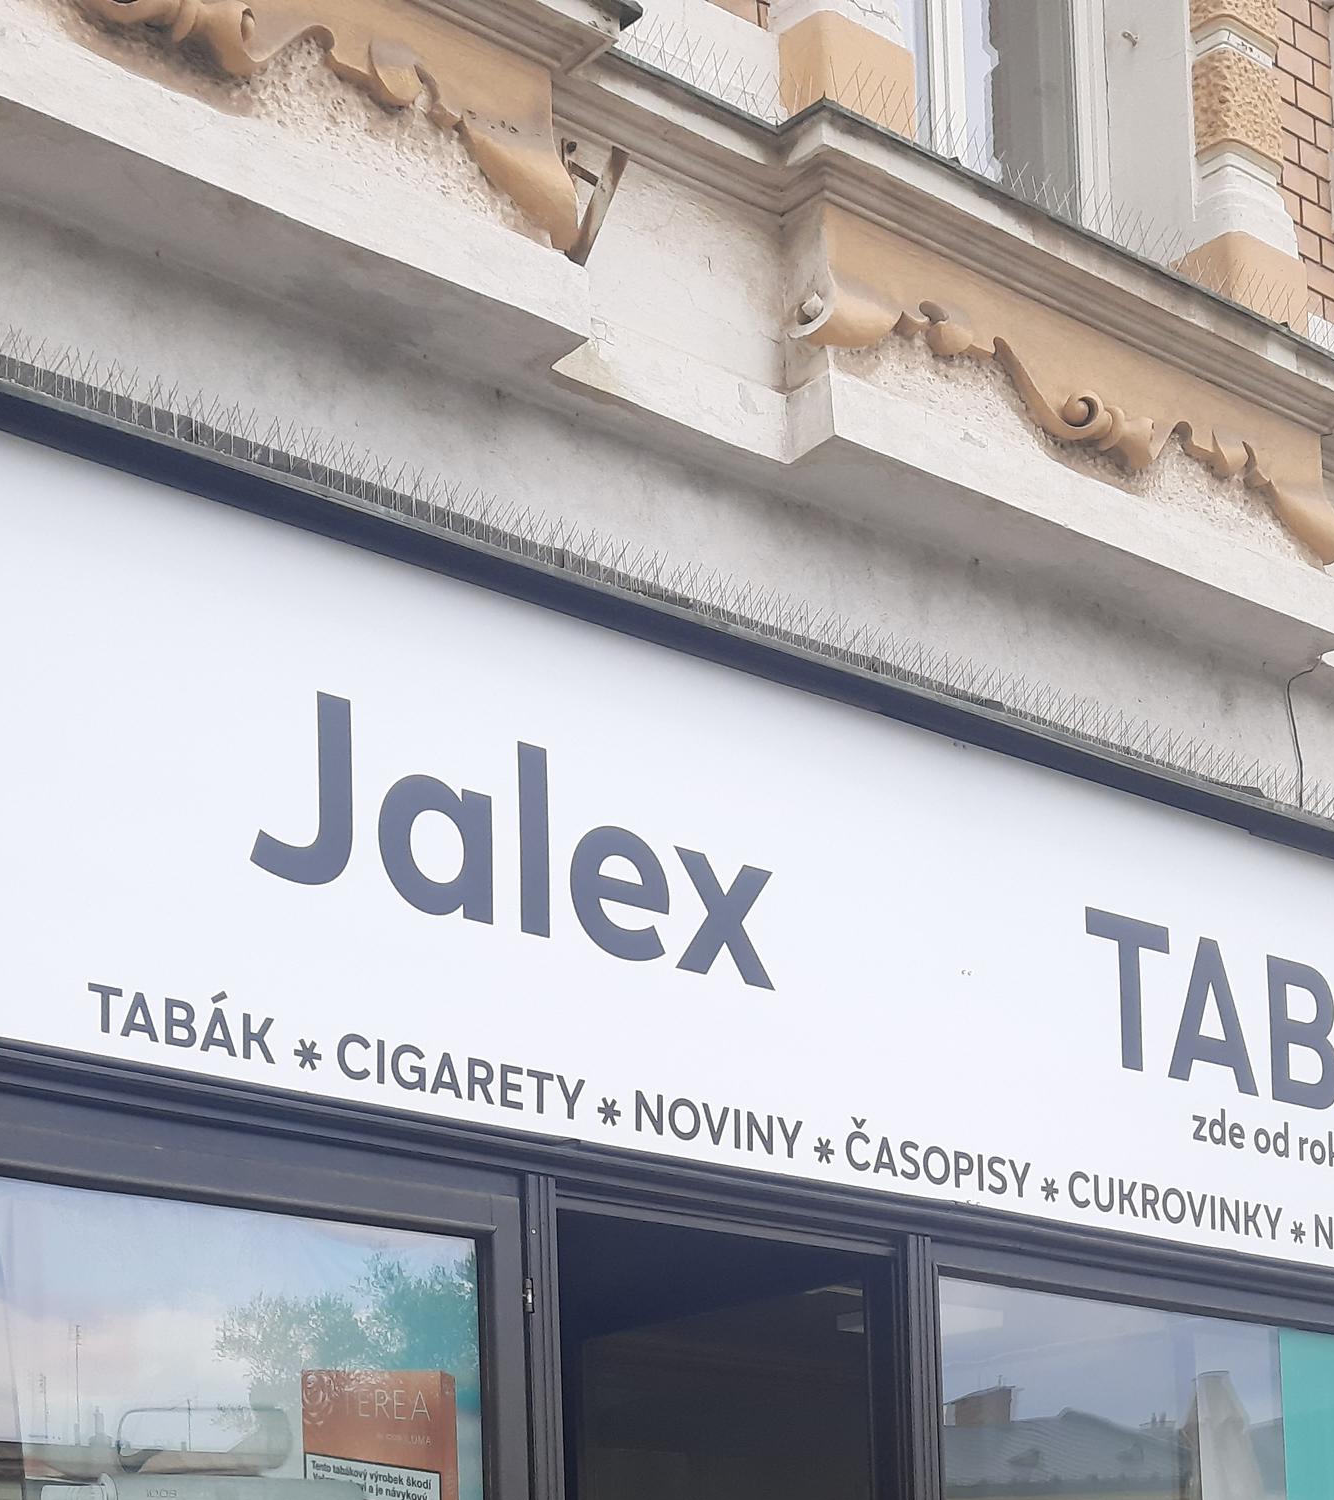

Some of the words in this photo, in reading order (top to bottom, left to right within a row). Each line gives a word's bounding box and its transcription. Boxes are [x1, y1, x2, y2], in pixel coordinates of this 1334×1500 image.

[250, 691, 775, 990] Jalex
[88, 982, 275, 1064] TABÁK
[337, 1034, 585, 1120] CIGARETY
[635, 1089, 803, 1159] NOVINY
[845, 1116, 1031, 1199] ČASOPISY
[1068, 1172, 1283, 1242] CUKROVINKY
[1193, 1109, 1245, 1150] zde
[1255, 1120, 1290, 1159] od
[311, 1460, 332, 1473] Tento
[369, 1470, 404, 1486] výrobek
[406, 1476, 432, 1490] škodí
